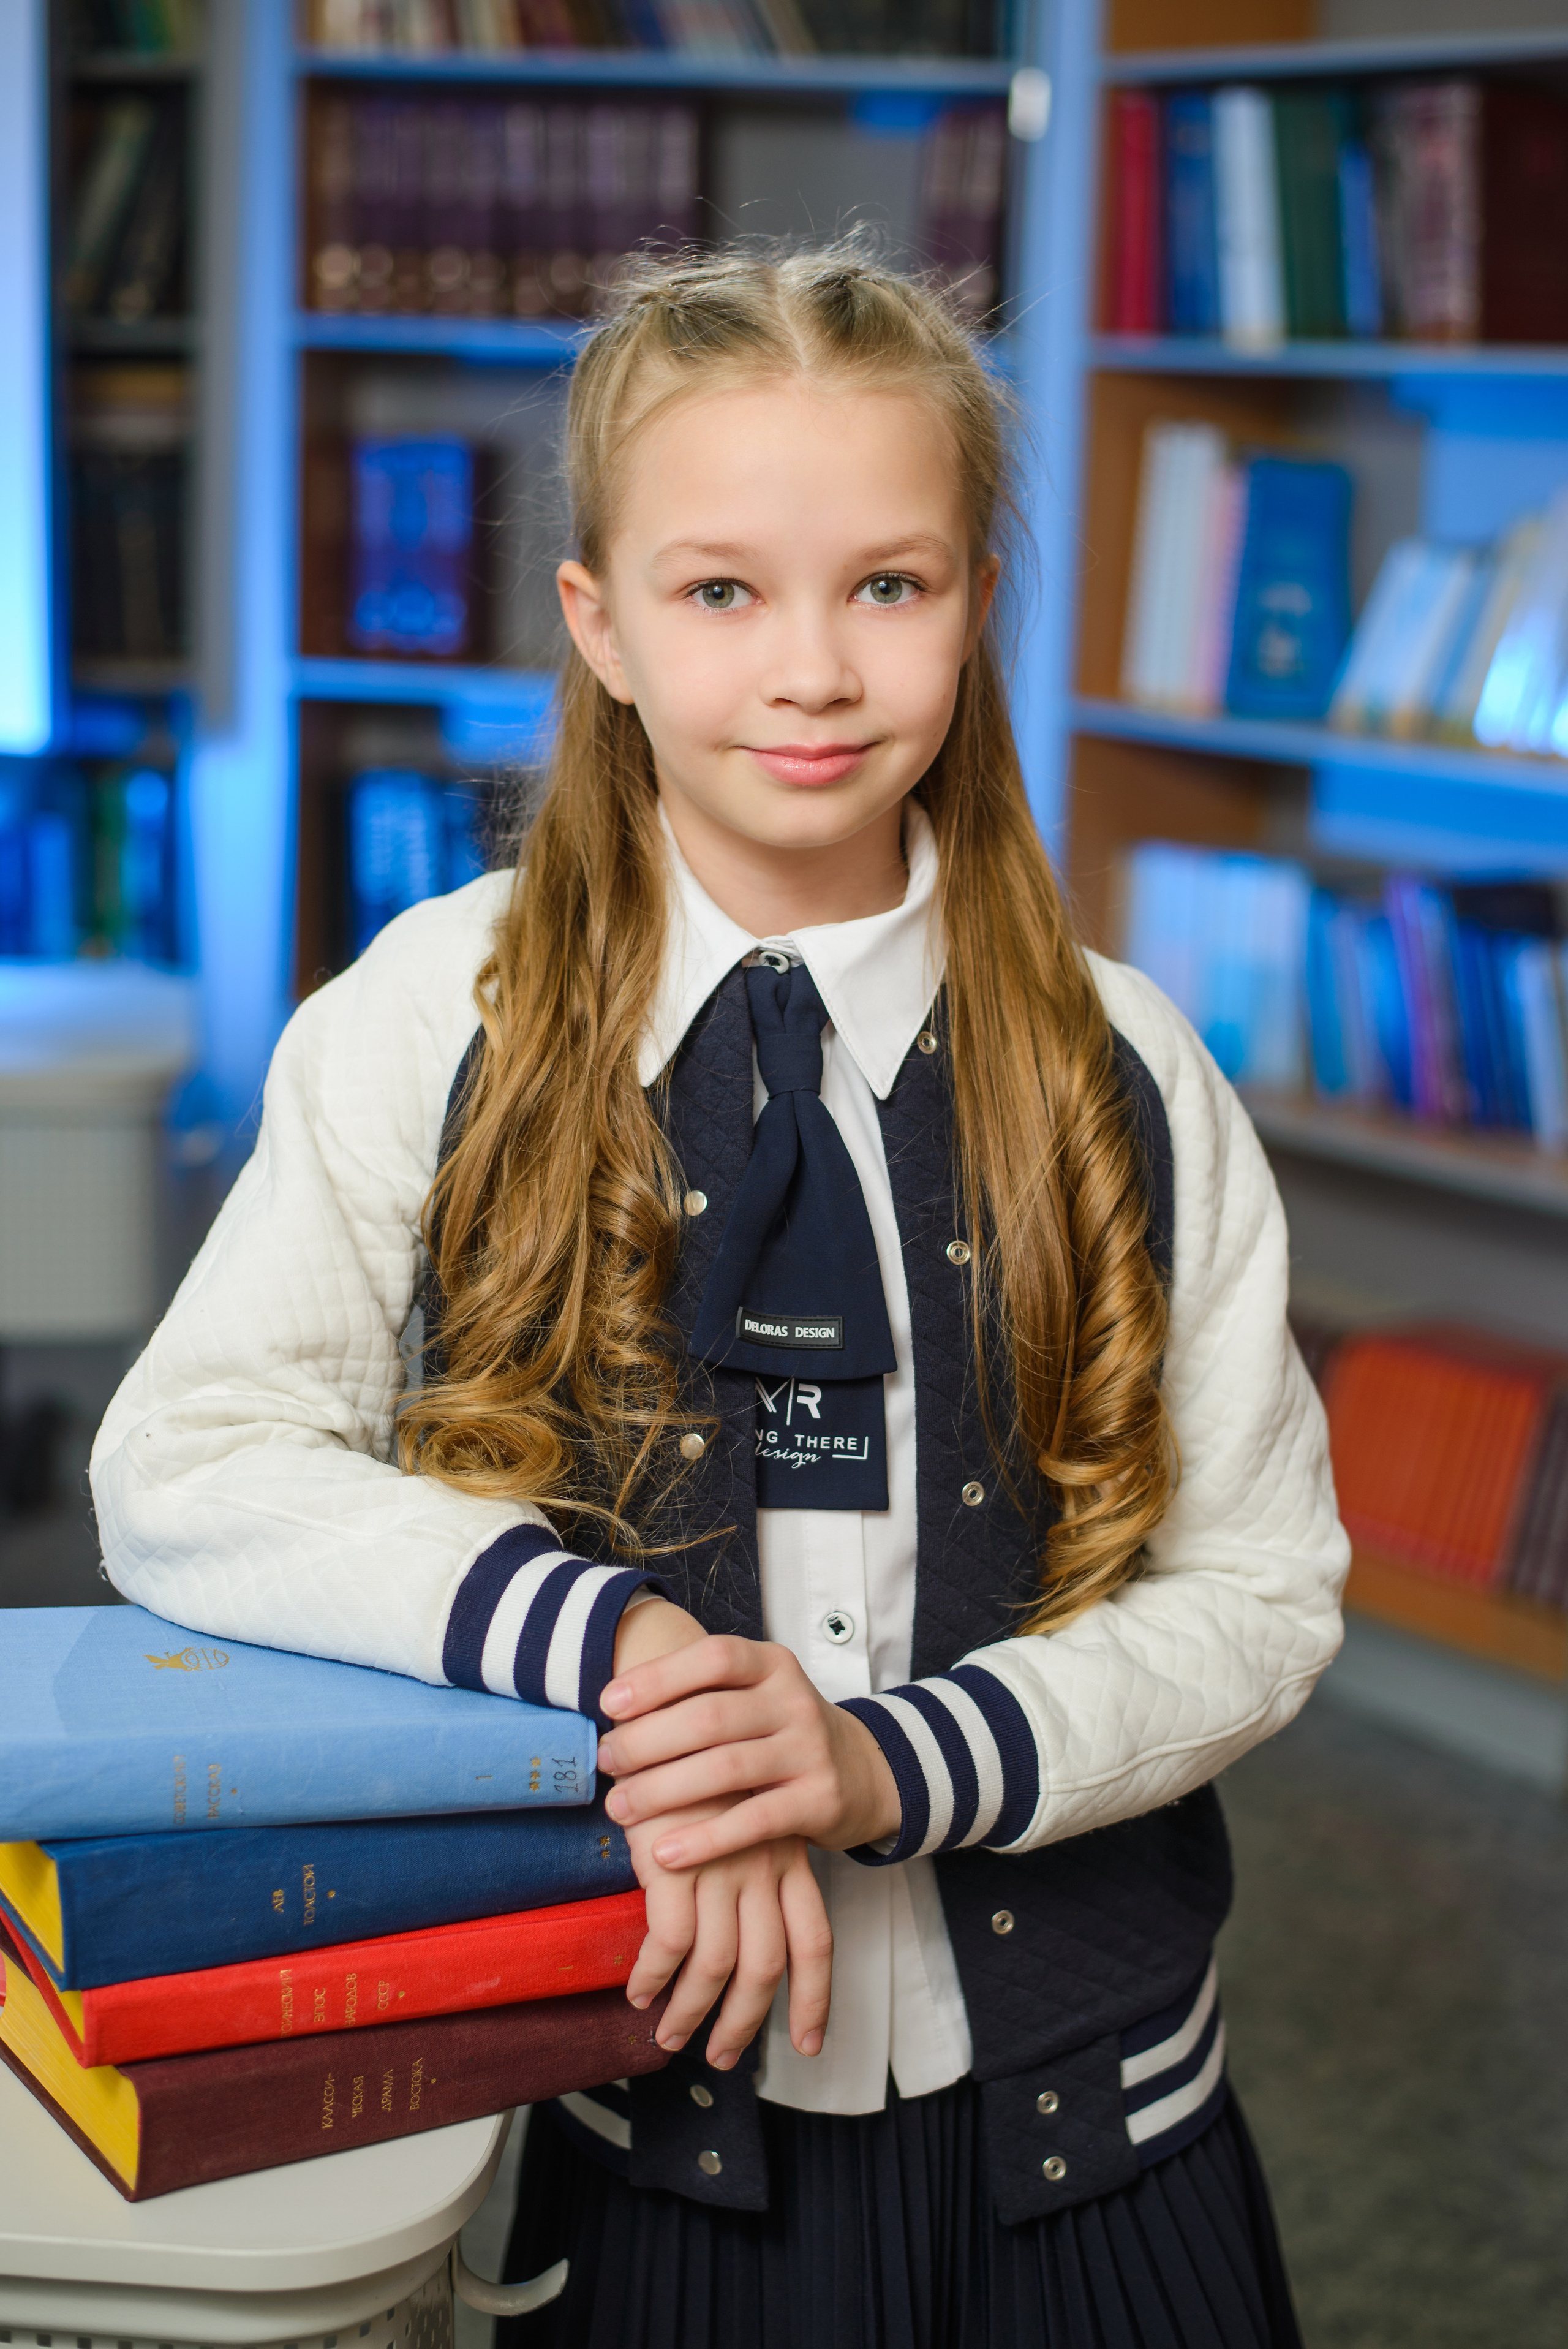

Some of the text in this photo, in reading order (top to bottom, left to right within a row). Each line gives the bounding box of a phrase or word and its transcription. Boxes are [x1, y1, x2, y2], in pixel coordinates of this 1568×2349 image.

[745, 1319, 835, 1338] DELORAS DESIGN
[794, 1434, 858, 1450] THERE
[174, 1755, 186, 1825] СОВЕТСКИЙ
[208, 1763, 221, 1818] РАССКАЗ
[552, 1757, 579, 1793] 181
[272, 1889, 284, 1913] ЛЕВ
[303, 1864, 315, 1925] ТОЛСТОЙ
[280, 1969, 293, 2038] РОИЧЕСКИЙ
[314, 1988, 326, 2022] ЭПОС
[344, 1973, 357, 2027] НАРОДОВ
[377, 1980, 389, 2010] СССР
[352, 2075, 364, 2119] ЧЕСКАЯ
[381, 2068, 393, 2111] ДРАМА
[409, 2057, 423, 2111] ВОСТОКА
